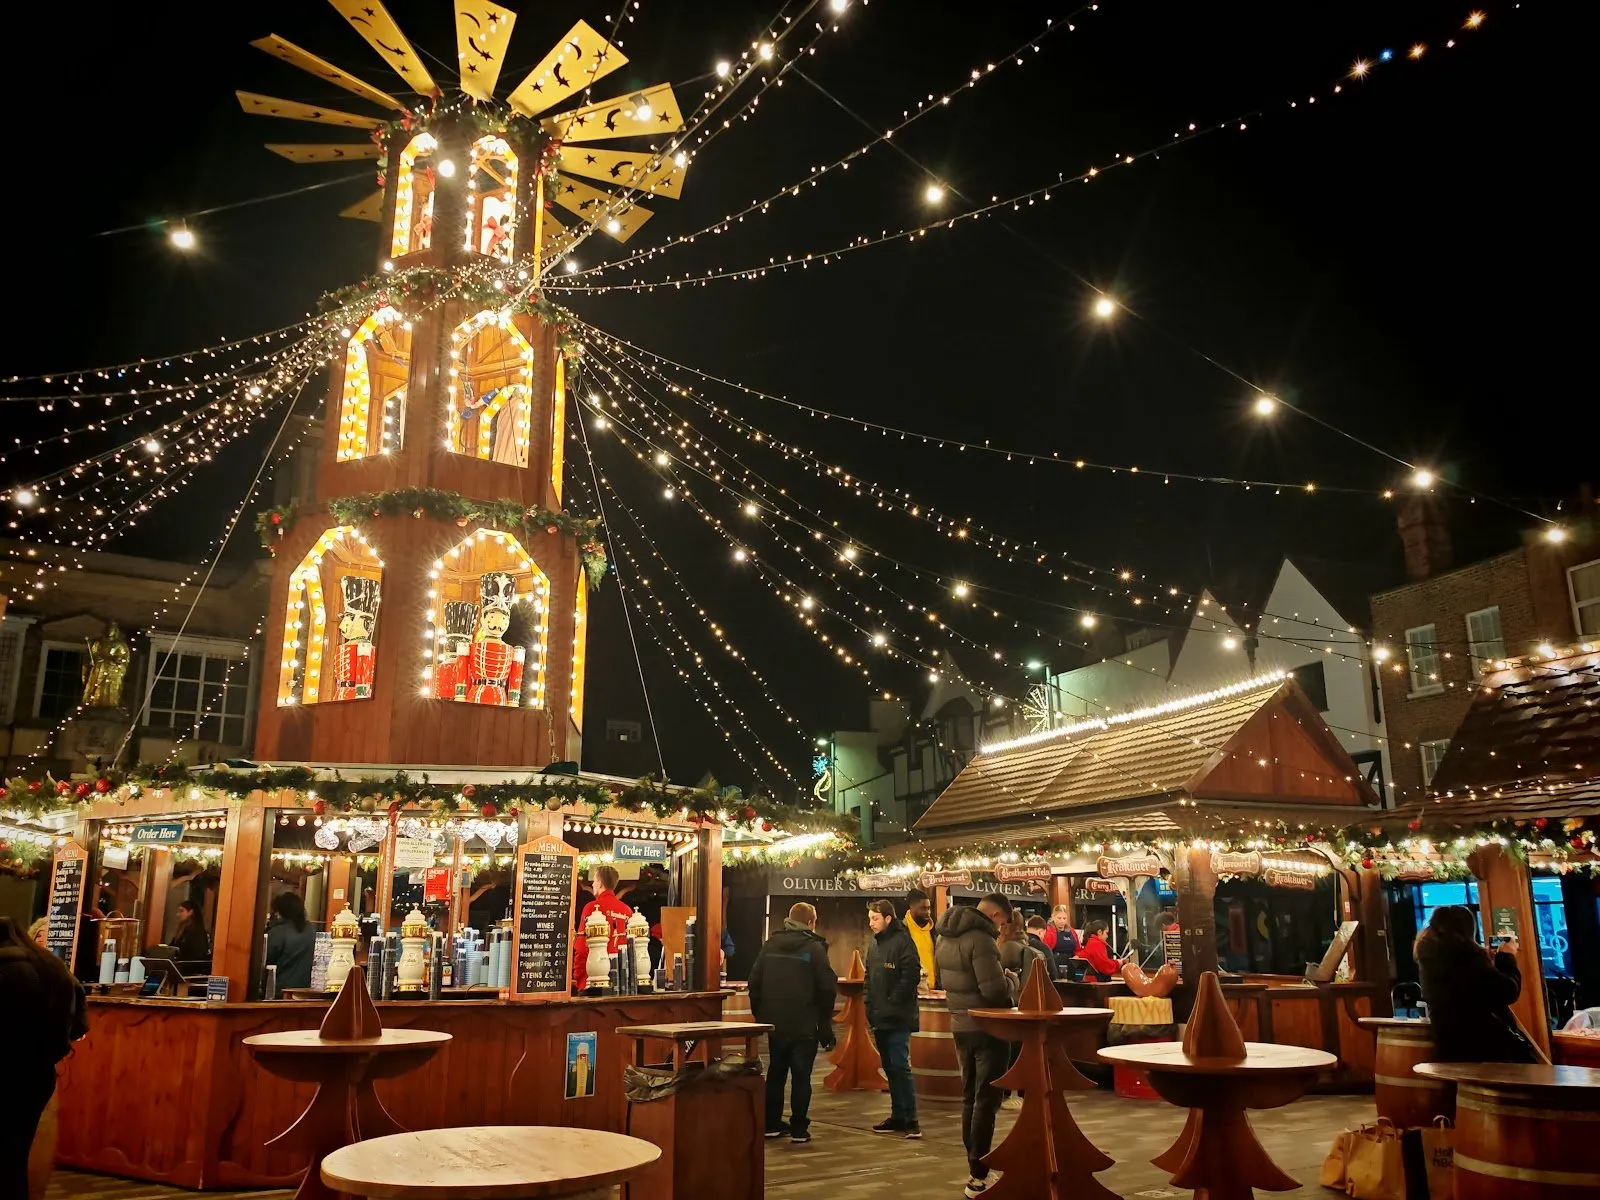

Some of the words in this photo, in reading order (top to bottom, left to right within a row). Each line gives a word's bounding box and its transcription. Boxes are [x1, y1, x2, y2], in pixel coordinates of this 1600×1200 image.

[137, 828, 159, 839] Order
[159, 827, 177, 839] Here
[535, 842, 563, 853] MENU
[620, 844, 642, 856] Order
[643, 846, 661, 857] Here
[1103, 859, 1151, 875] Krakauer
[783, 877, 857, 892] OLIVIERS
[926, 872, 966, 886] Bratwurst
[1272, 871, 1309, 886] Krakauer
[520, 932, 537, 940] Merlot
